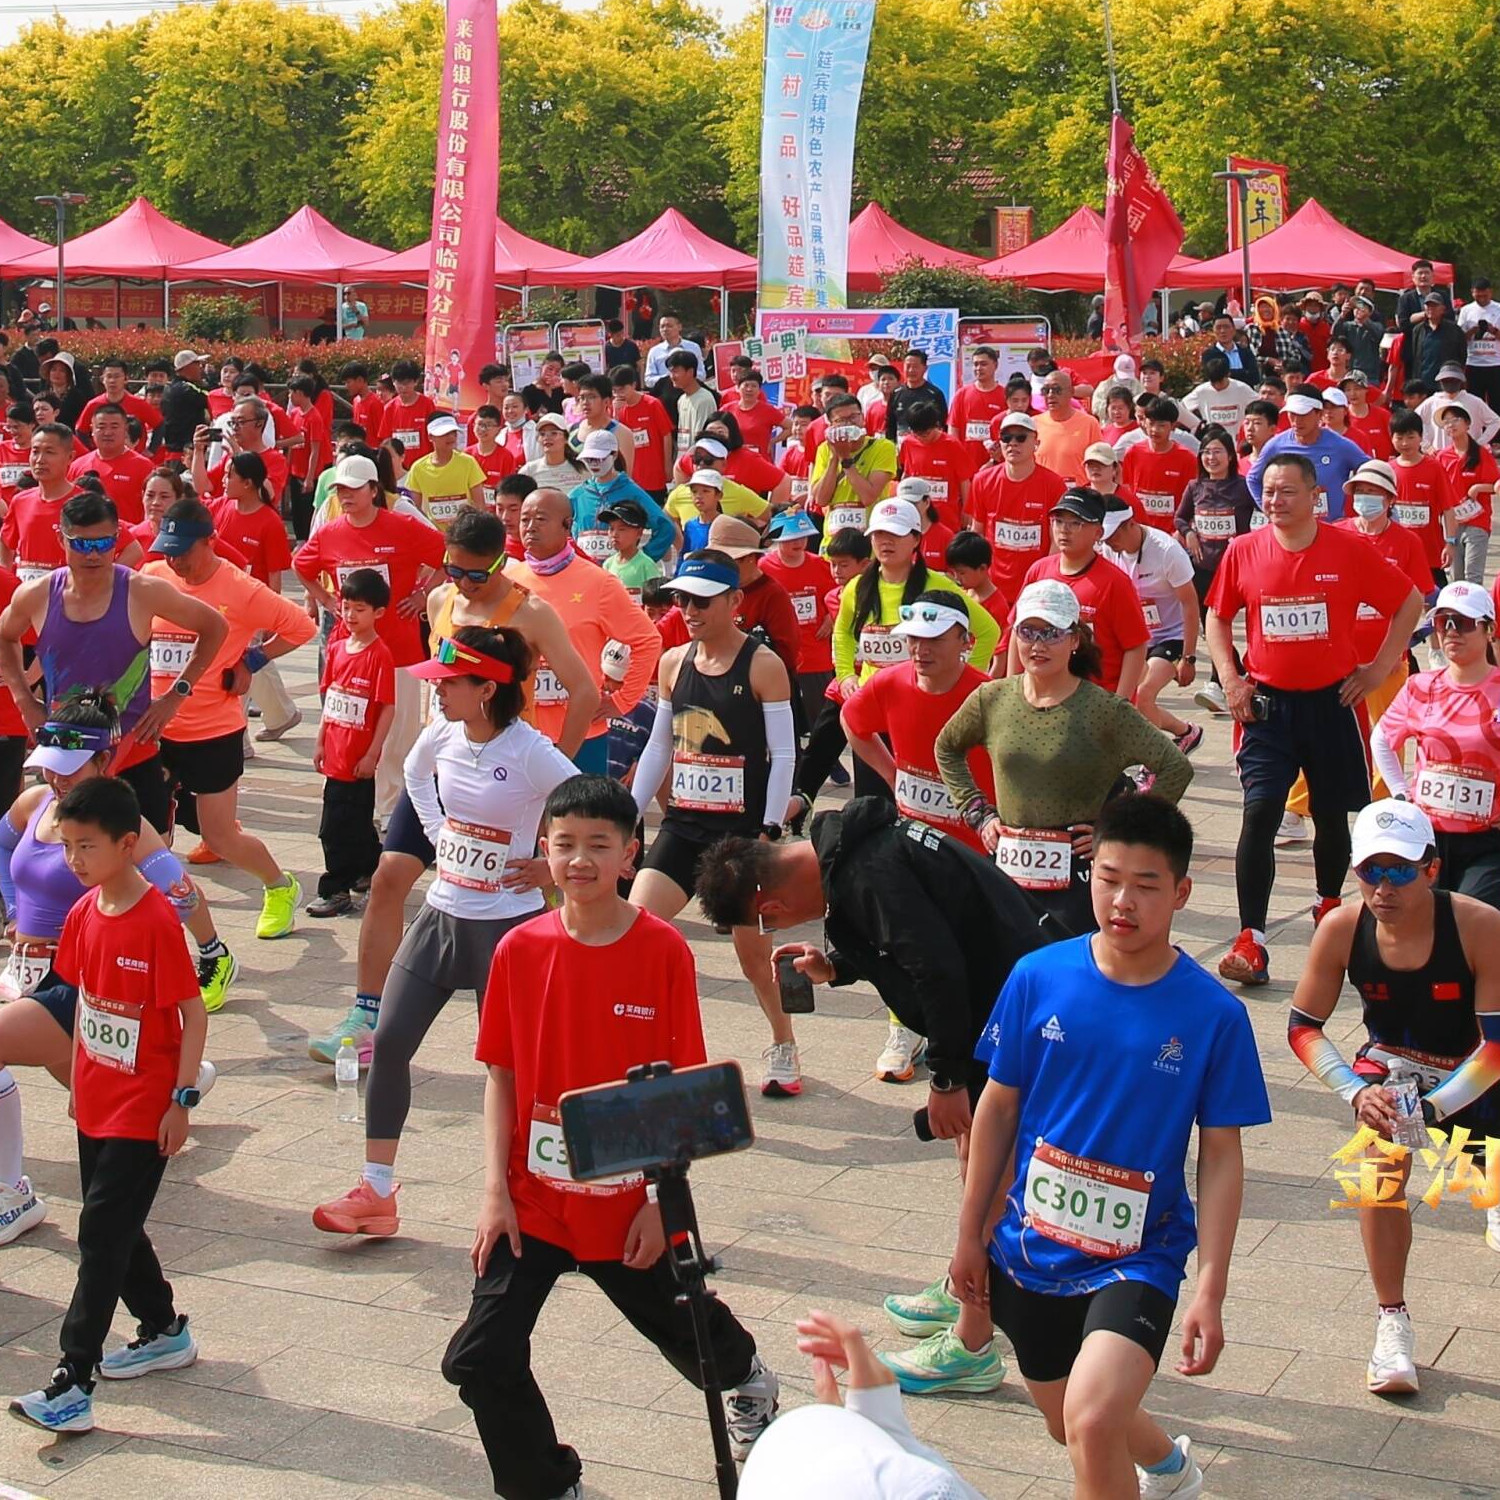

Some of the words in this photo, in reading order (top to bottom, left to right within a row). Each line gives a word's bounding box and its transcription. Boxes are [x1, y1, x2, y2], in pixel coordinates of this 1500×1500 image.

[429, 18, 474, 338] 莱商银行股份有限公司临沂分行
[996, 528, 1038, 541] A1044
[1265, 610, 1323, 628] A1017
[675, 773, 736, 793] A1021
[1420, 779, 1485, 806] B2131
[438, 837, 498, 872] B2076
[1000, 848, 1063, 870] B2022
[1031, 1175, 1133, 1231] C3019
